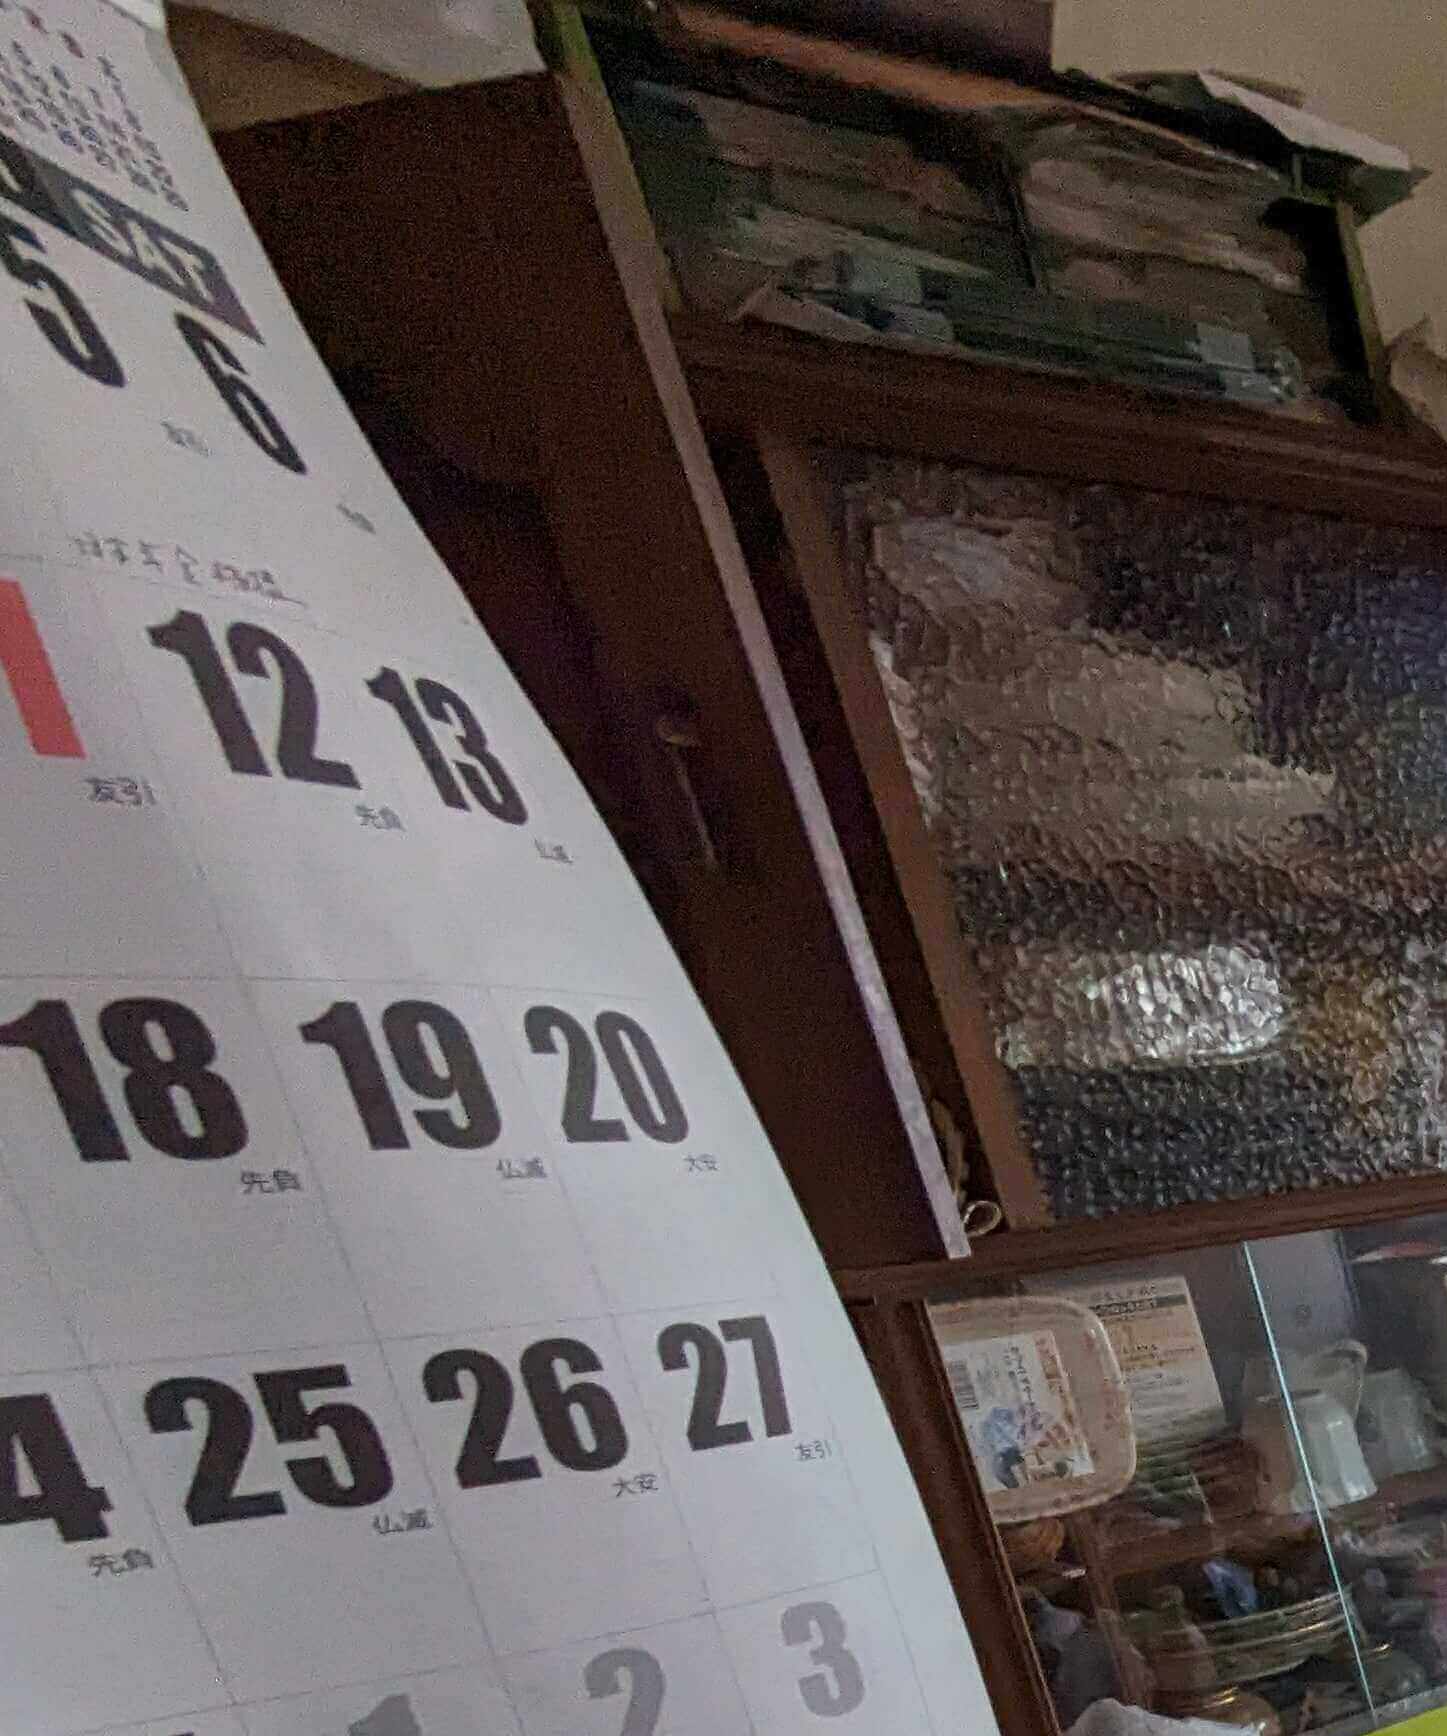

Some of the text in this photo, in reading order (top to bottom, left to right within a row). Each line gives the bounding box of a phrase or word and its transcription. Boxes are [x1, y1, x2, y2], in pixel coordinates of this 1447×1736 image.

[0, 212, 126, 388] 5
[73, 188, 214, 301] SAT
[174, 313, 307, 475] 6
[147, 611, 361, 789] 12
[366, 666, 528, 825] 13
[0, 996, 249, 1163] 18
[298, 1000, 501, 1151] 19
[524, 1005, 688, 1143] 20
[240, 1168, 303, 1194] 先負
[142, 1363, 394, 1528] 25
[421, 1337, 628, 1490] 26
[657, 1329, 792, 1449] 27
[795, 1439, 832, 1462] 友引
[372, 1508, 434, 1535] 仏滅
[613, 1473, 660, 1499] 大安
[87, 1548, 154, 1577] 先負
[781, 1601, 866, 1718] 3
